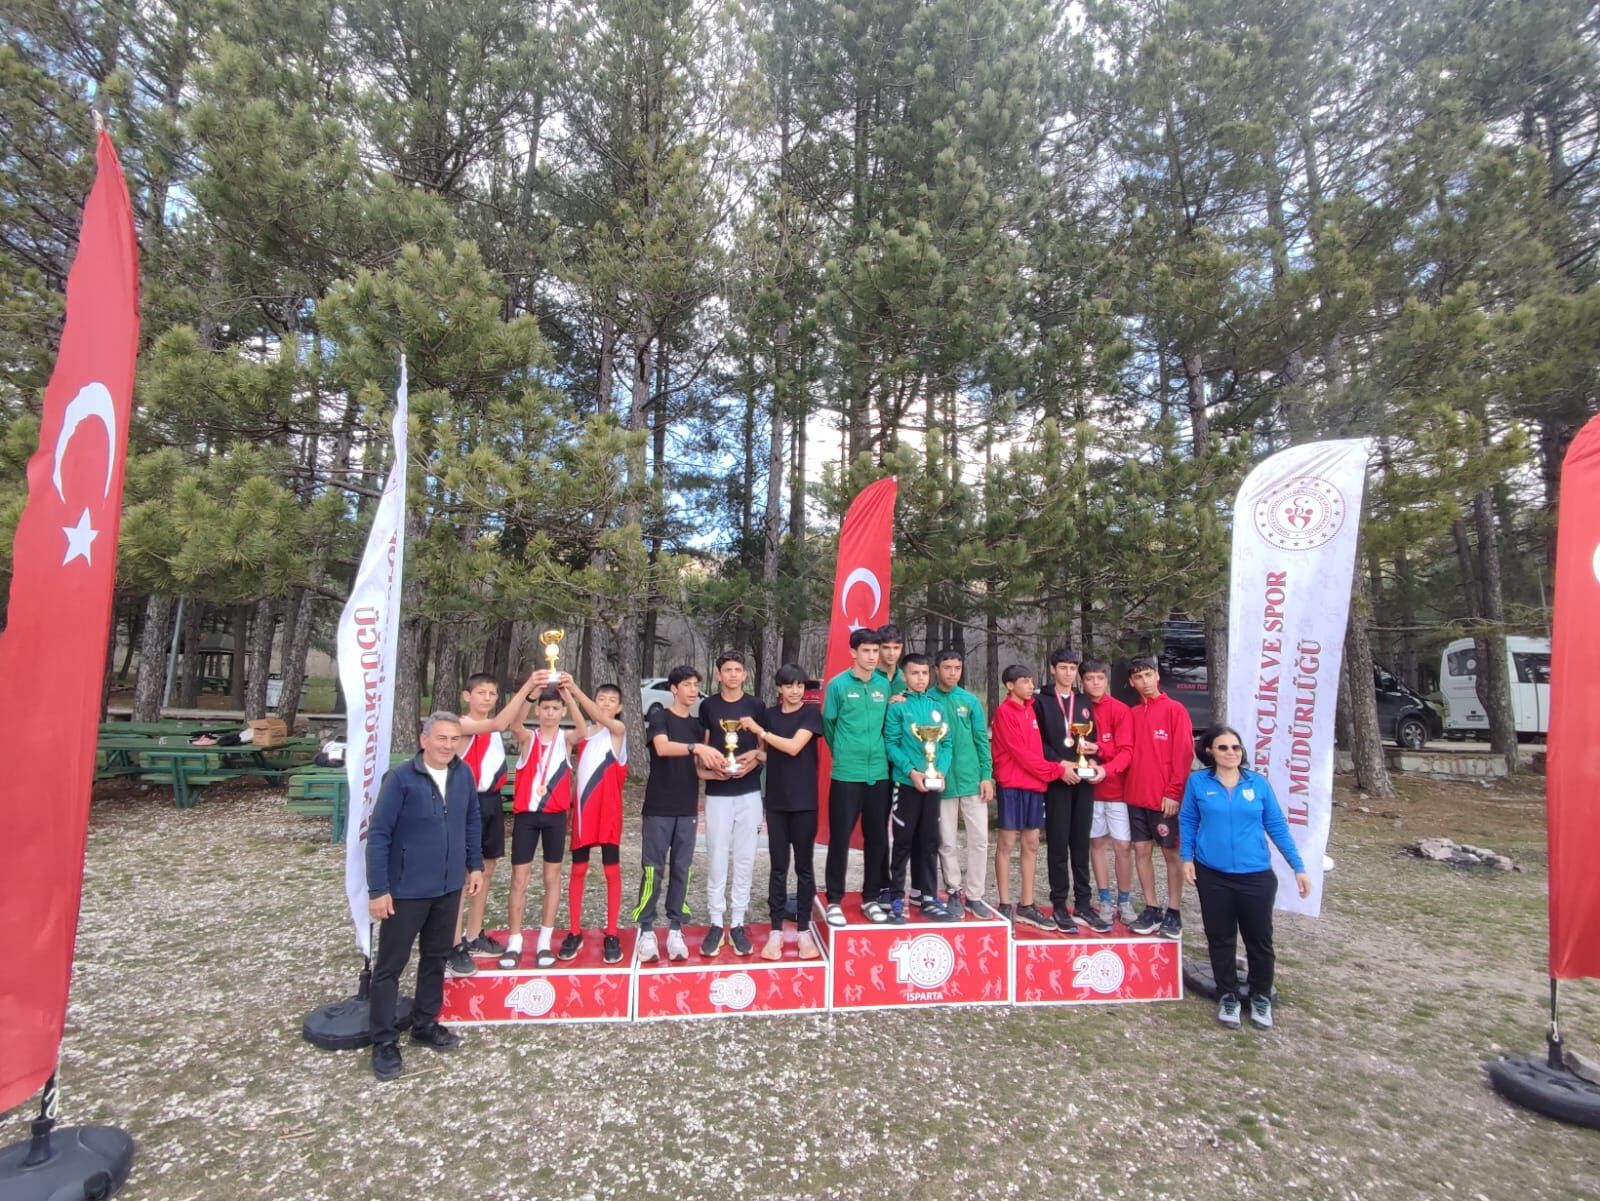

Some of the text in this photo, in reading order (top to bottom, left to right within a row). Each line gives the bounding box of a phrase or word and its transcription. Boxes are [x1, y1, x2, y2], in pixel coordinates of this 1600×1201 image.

[1264, 570, 1287, 633] SPOR
[1260, 638, 1282, 669] VE
[1285, 638, 1321, 796] MÜDÜRLÜĞÜ
[906, 991, 944, 1001] ISPARTA
